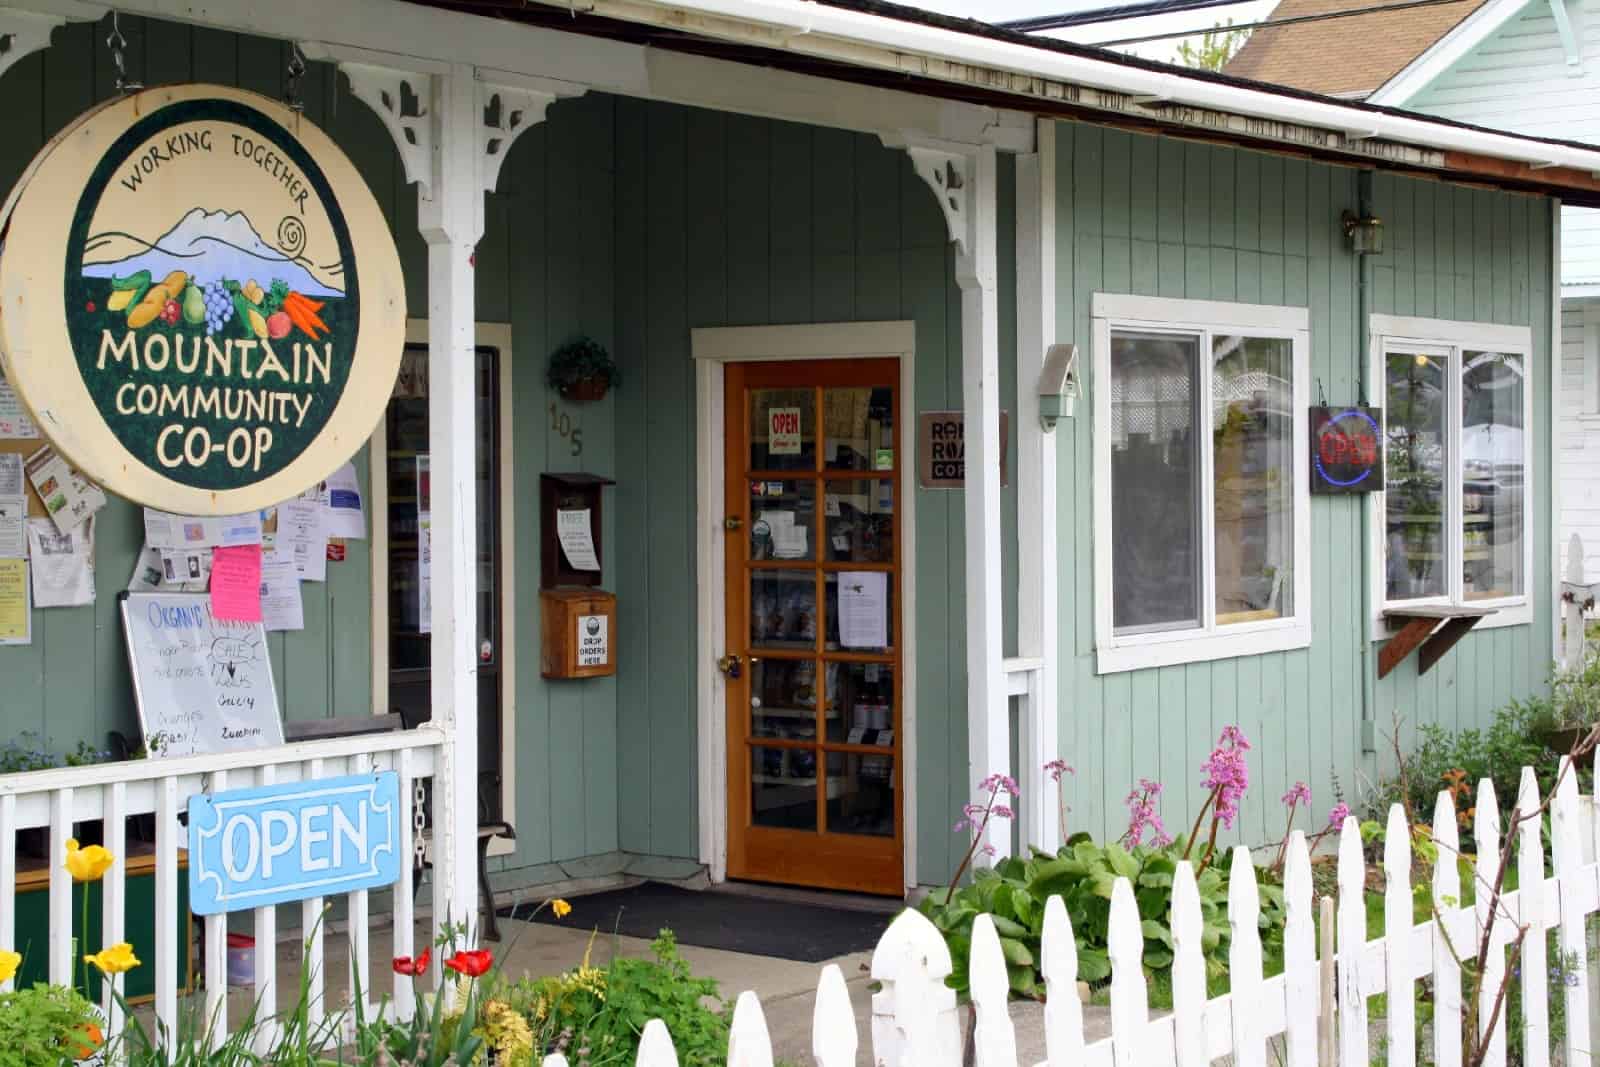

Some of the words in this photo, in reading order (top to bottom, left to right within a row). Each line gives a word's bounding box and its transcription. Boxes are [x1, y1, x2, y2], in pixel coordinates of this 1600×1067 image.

[121, 130, 212, 192] WORKING
[231, 134, 309, 214] TOGETHER
[96, 329, 332, 384] MOUNTAIN
[116, 382, 313, 427] COMMUNITY
[772, 413, 799, 434] OPEN
[156, 424, 273, 472] CO-OP
[1320, 432, 1377, 464] OPEN
[579, 647, 605, 656] ORDERS
[584, 637, 602, 645] DROP
[584, 656, 601, 664] HERE
[222, 799, 368, 882] OPEN
